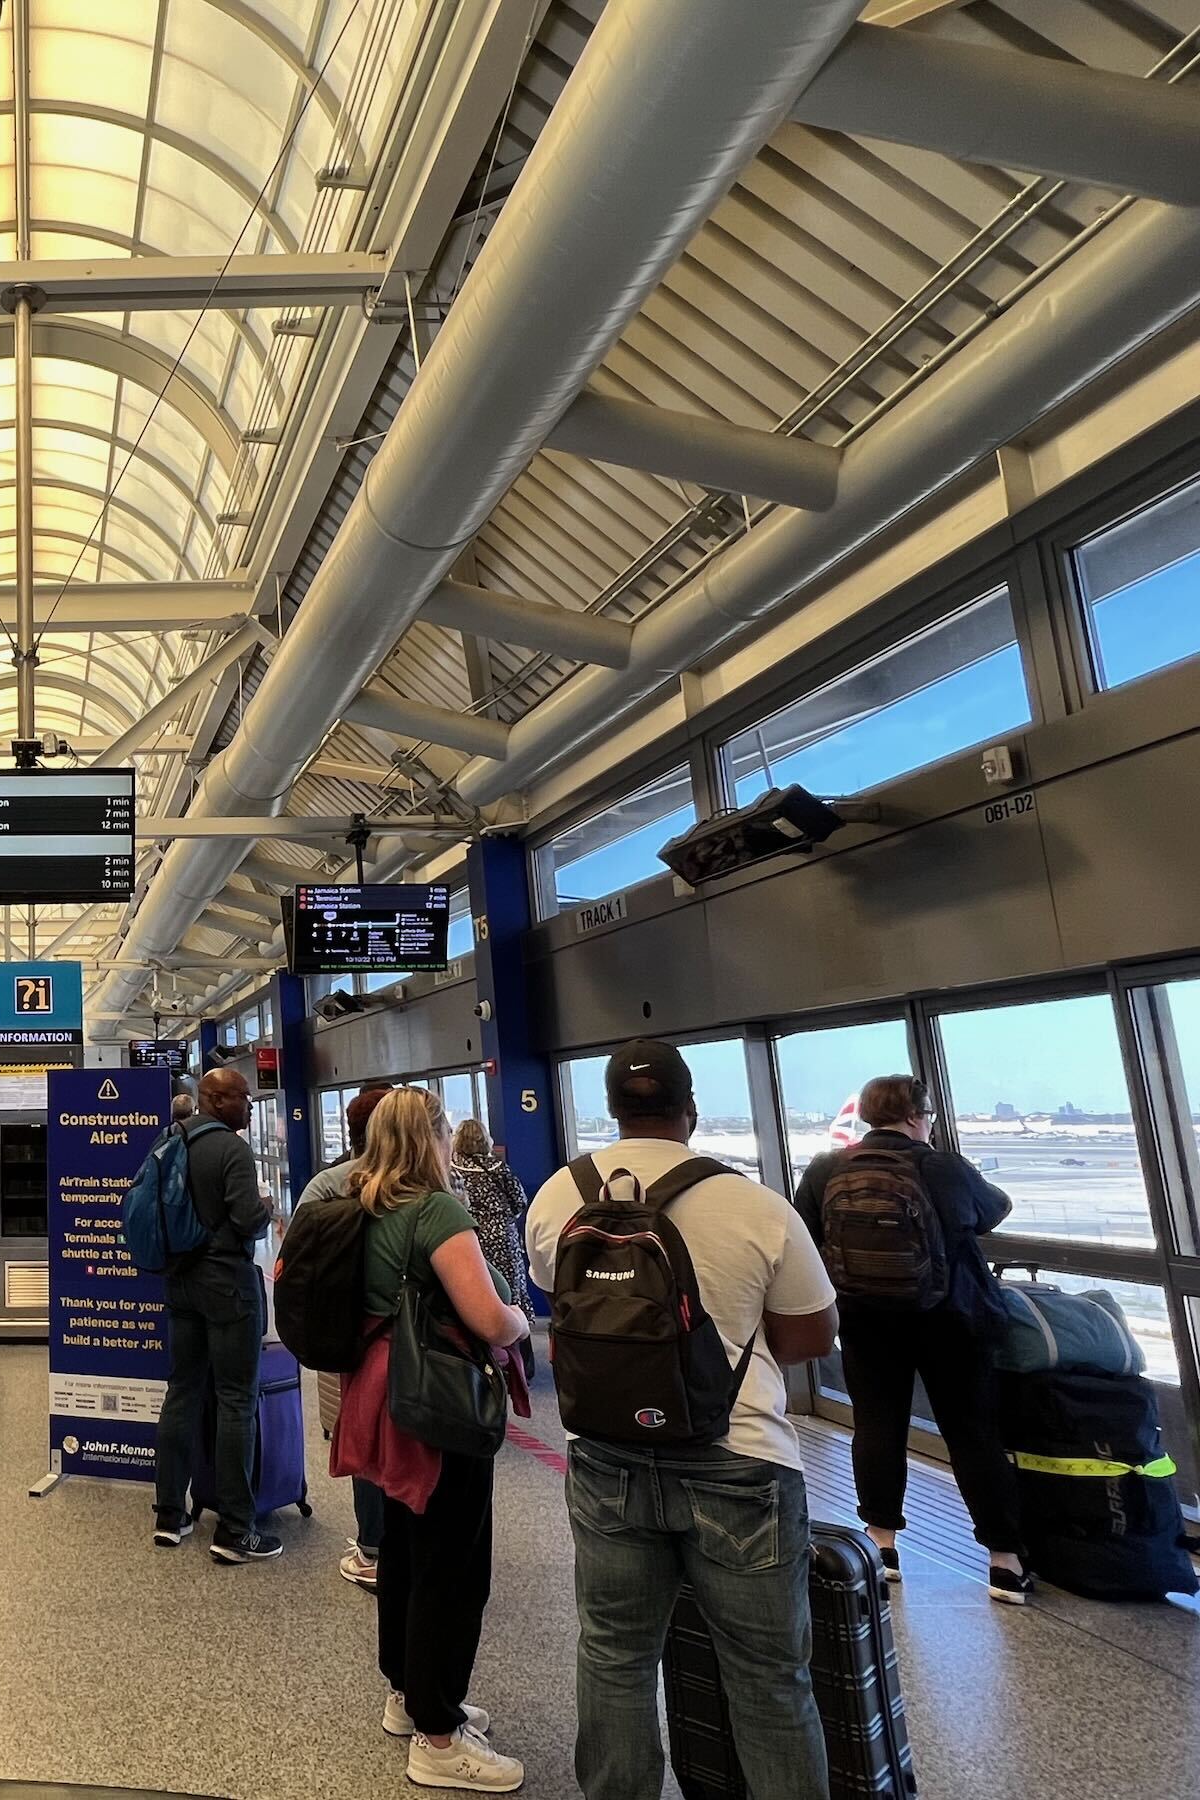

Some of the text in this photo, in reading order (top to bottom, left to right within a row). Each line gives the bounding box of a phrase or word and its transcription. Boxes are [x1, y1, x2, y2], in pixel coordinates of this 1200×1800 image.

[580, 898, 622, 930] TRACK 1
[473, 915, 489, 942] T5
[520, 1090, 538, 1112] 5
[60, 1112, 158, 1126] Construction
[292, 1108, 302, 1120] 5
[90, 1131, 128, 1144] Alert
[59, 1177, 132, 1188] AirTrain Statio
[61, 1192, 122, 1205] temporarily
[75, 1218, 123, 1228] For acce
[64, 1233, 115, 1244] Terminals
[62, 1248, 100, 1259] shuttle
[102, 1250, 113, 1259] at
[96, 1265, 138, 1276] arrivals
[586, 1269, 634, 1280] SAMSUNG
[60, 1297, 164, 1313] Thank you for your
[69, 1316, 155, 1330] patience as we
[63, 1334, 163, 1350] build a better JFK
[82, 1441, 155, 1456] John F. Kenne
[82, 1452, 156, 1467] International Airport
